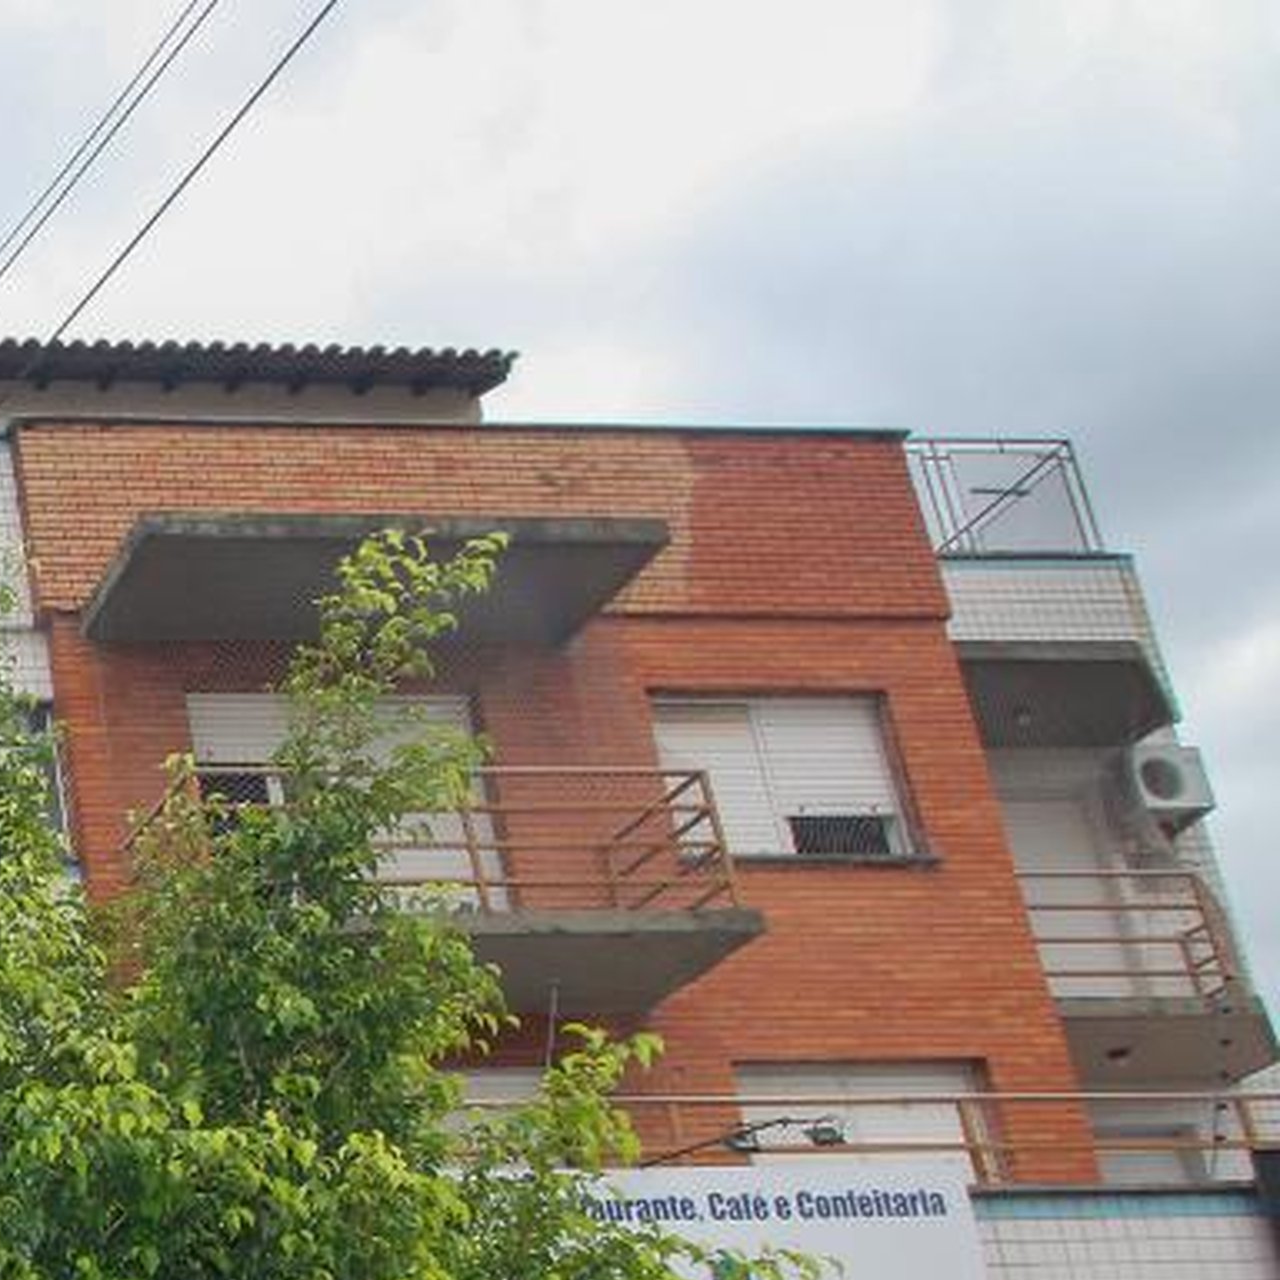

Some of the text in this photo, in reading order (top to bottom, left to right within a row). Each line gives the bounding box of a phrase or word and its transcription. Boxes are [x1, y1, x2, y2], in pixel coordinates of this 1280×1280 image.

[707, 1191, 769, 1221] Café
[774, 1195, 791, 1220] e
[796, 1189, 947, 1219] Confeitaria
